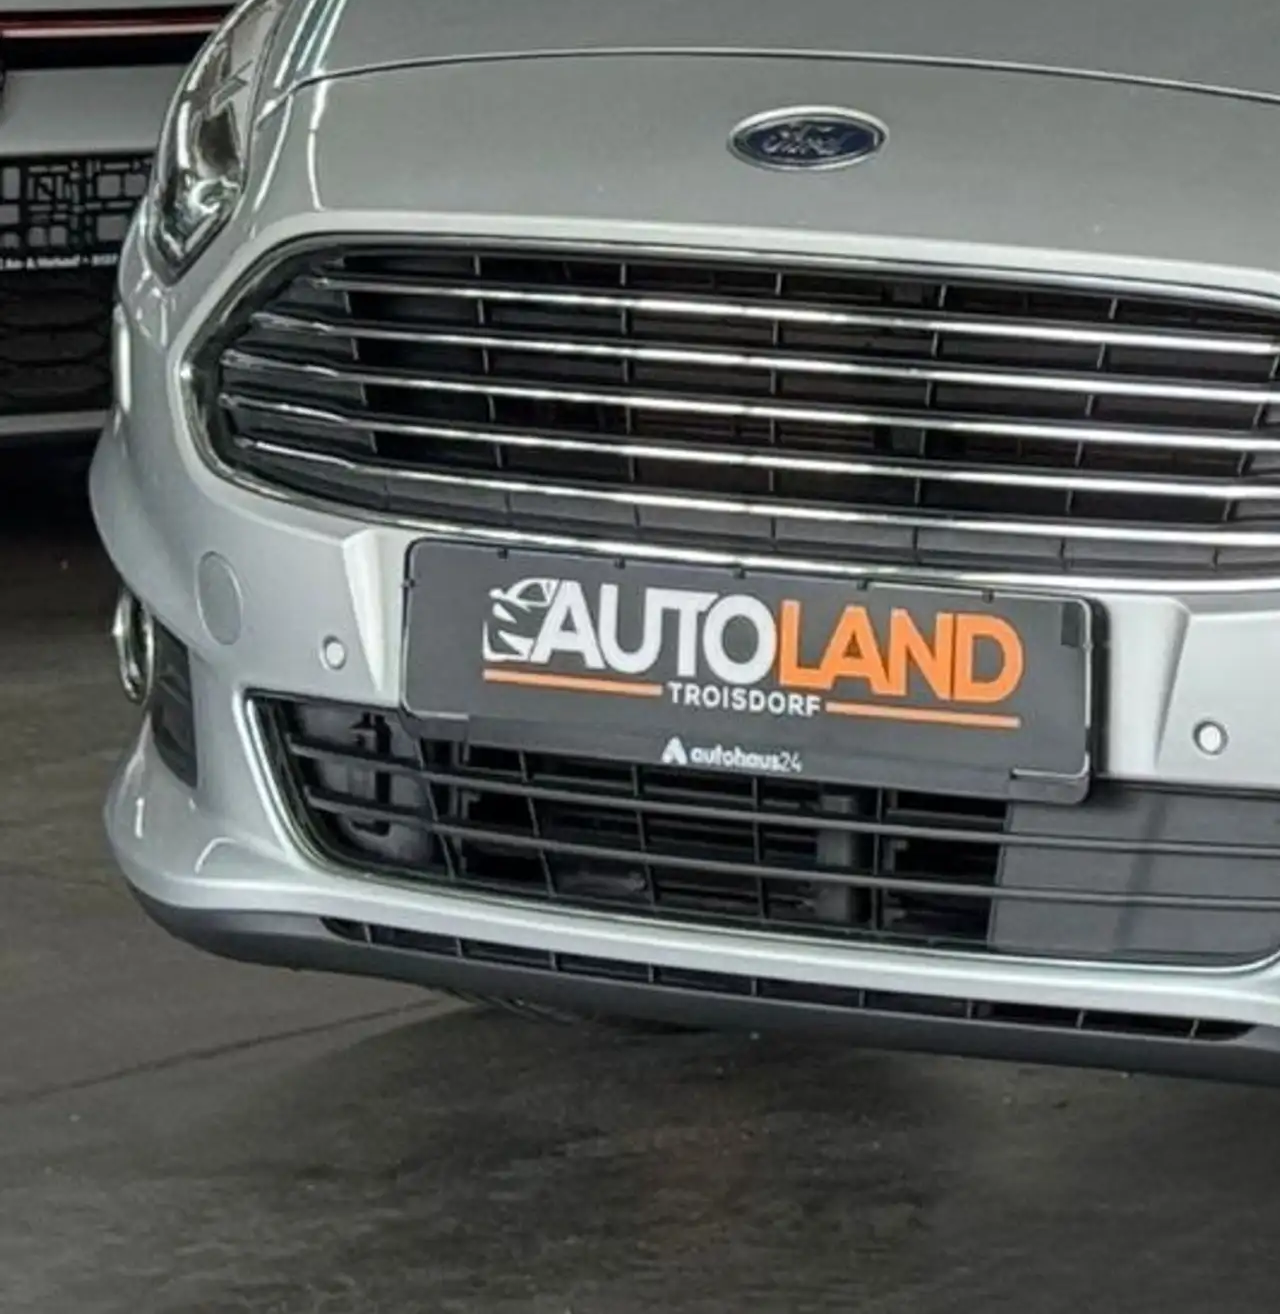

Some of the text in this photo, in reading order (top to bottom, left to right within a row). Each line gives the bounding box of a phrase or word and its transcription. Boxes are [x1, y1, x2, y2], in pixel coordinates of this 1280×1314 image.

[529, 579, 1024, 704] AUTOLAND
[667, 681, 822, 717] TROISDORF
[690, 743, 803, 773] autohaus24
